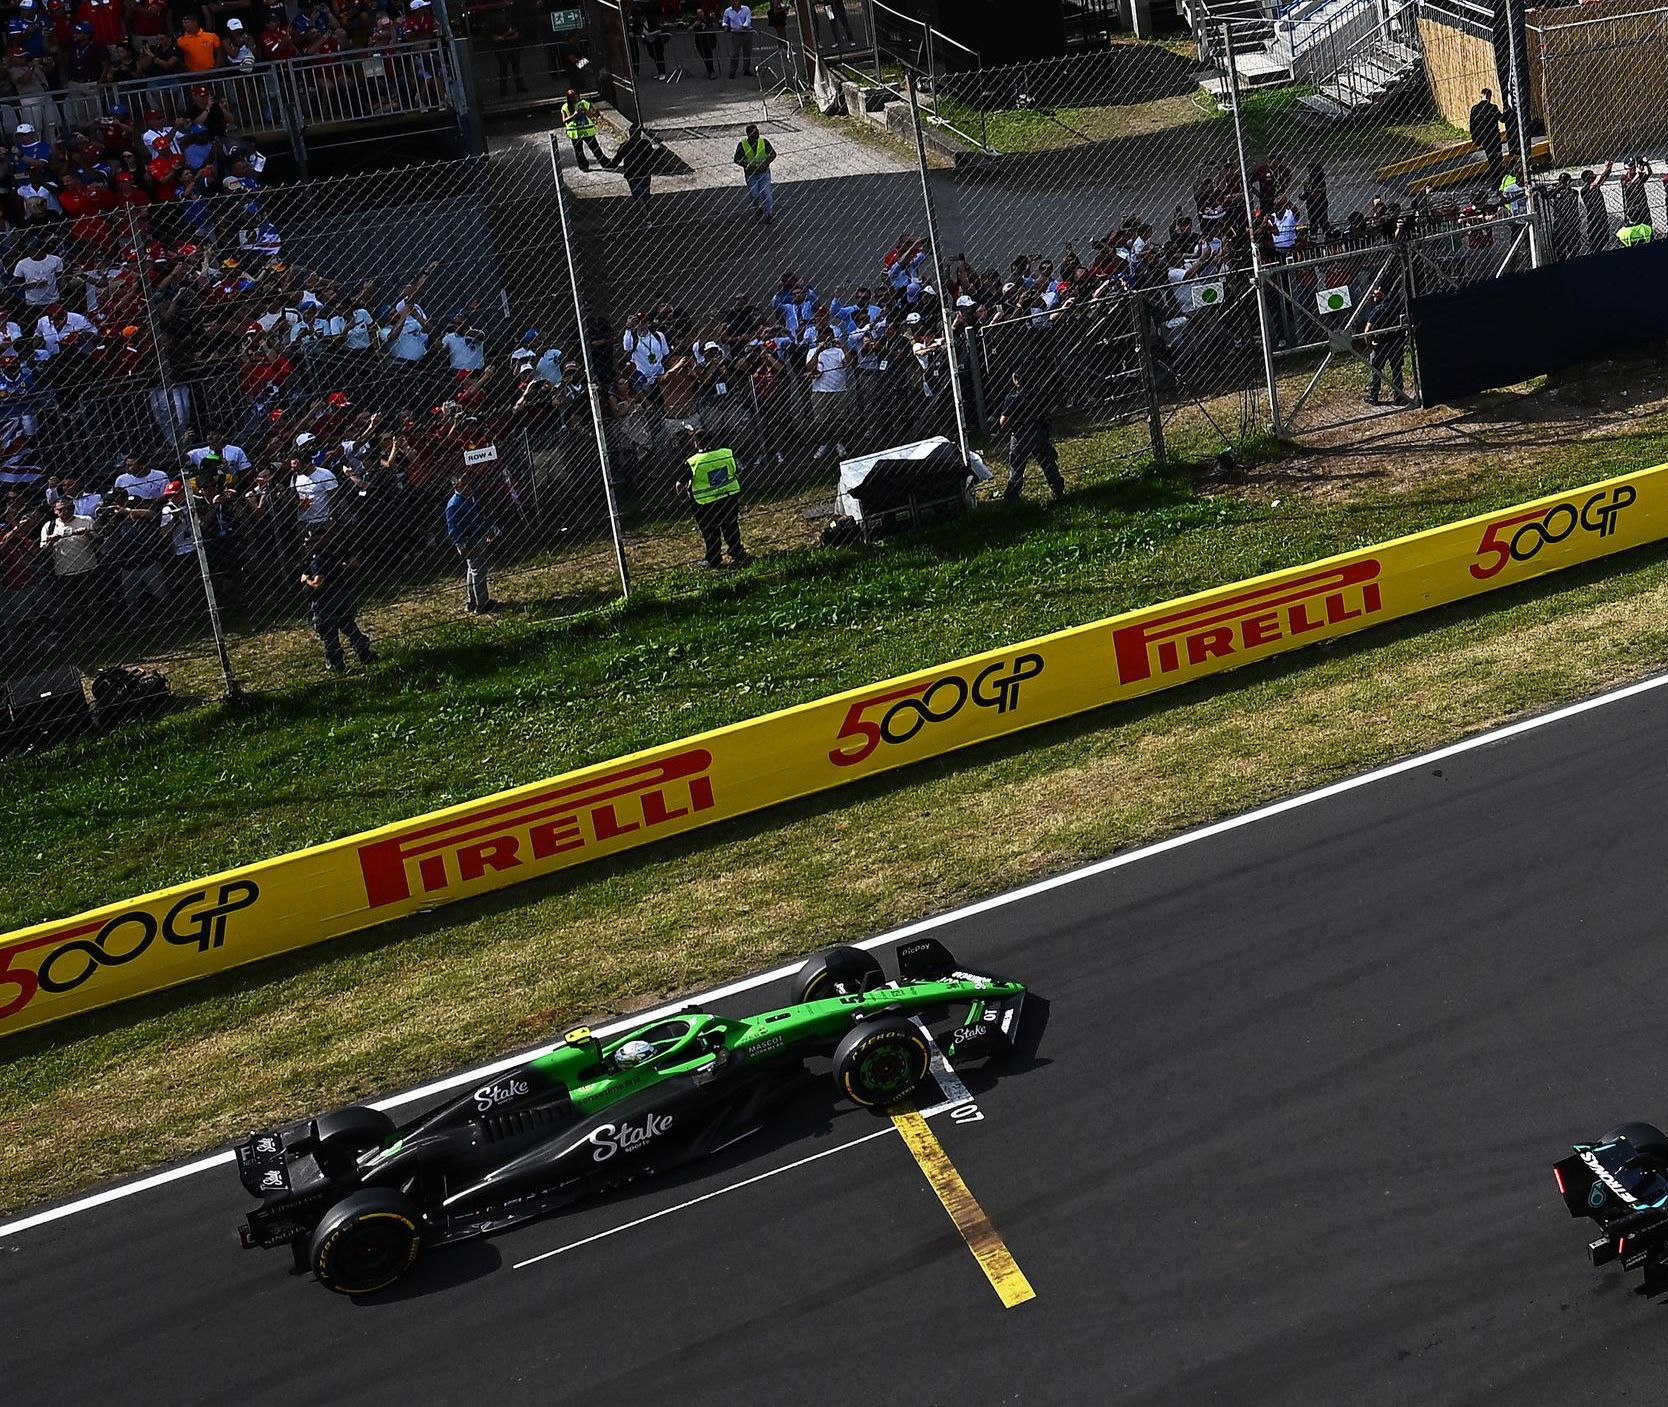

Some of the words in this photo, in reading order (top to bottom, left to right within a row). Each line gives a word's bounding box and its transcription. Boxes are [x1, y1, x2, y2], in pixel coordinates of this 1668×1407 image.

[468, 452, 486, 462] ROW
[359, 749, 713, 907] PIRELLI
[1113, 559, 1381, 685] PIRELLI
[902, 943, 930, 956] PicPay
[748, 1035, 783, 1053] MASCOT
[954, 1024, 987, 1044] Stake
[473, 1080, 529, 1112] Stake
[950, 1104, 985, 1124] 07
[589, 1113, 672, 1162] Stake
